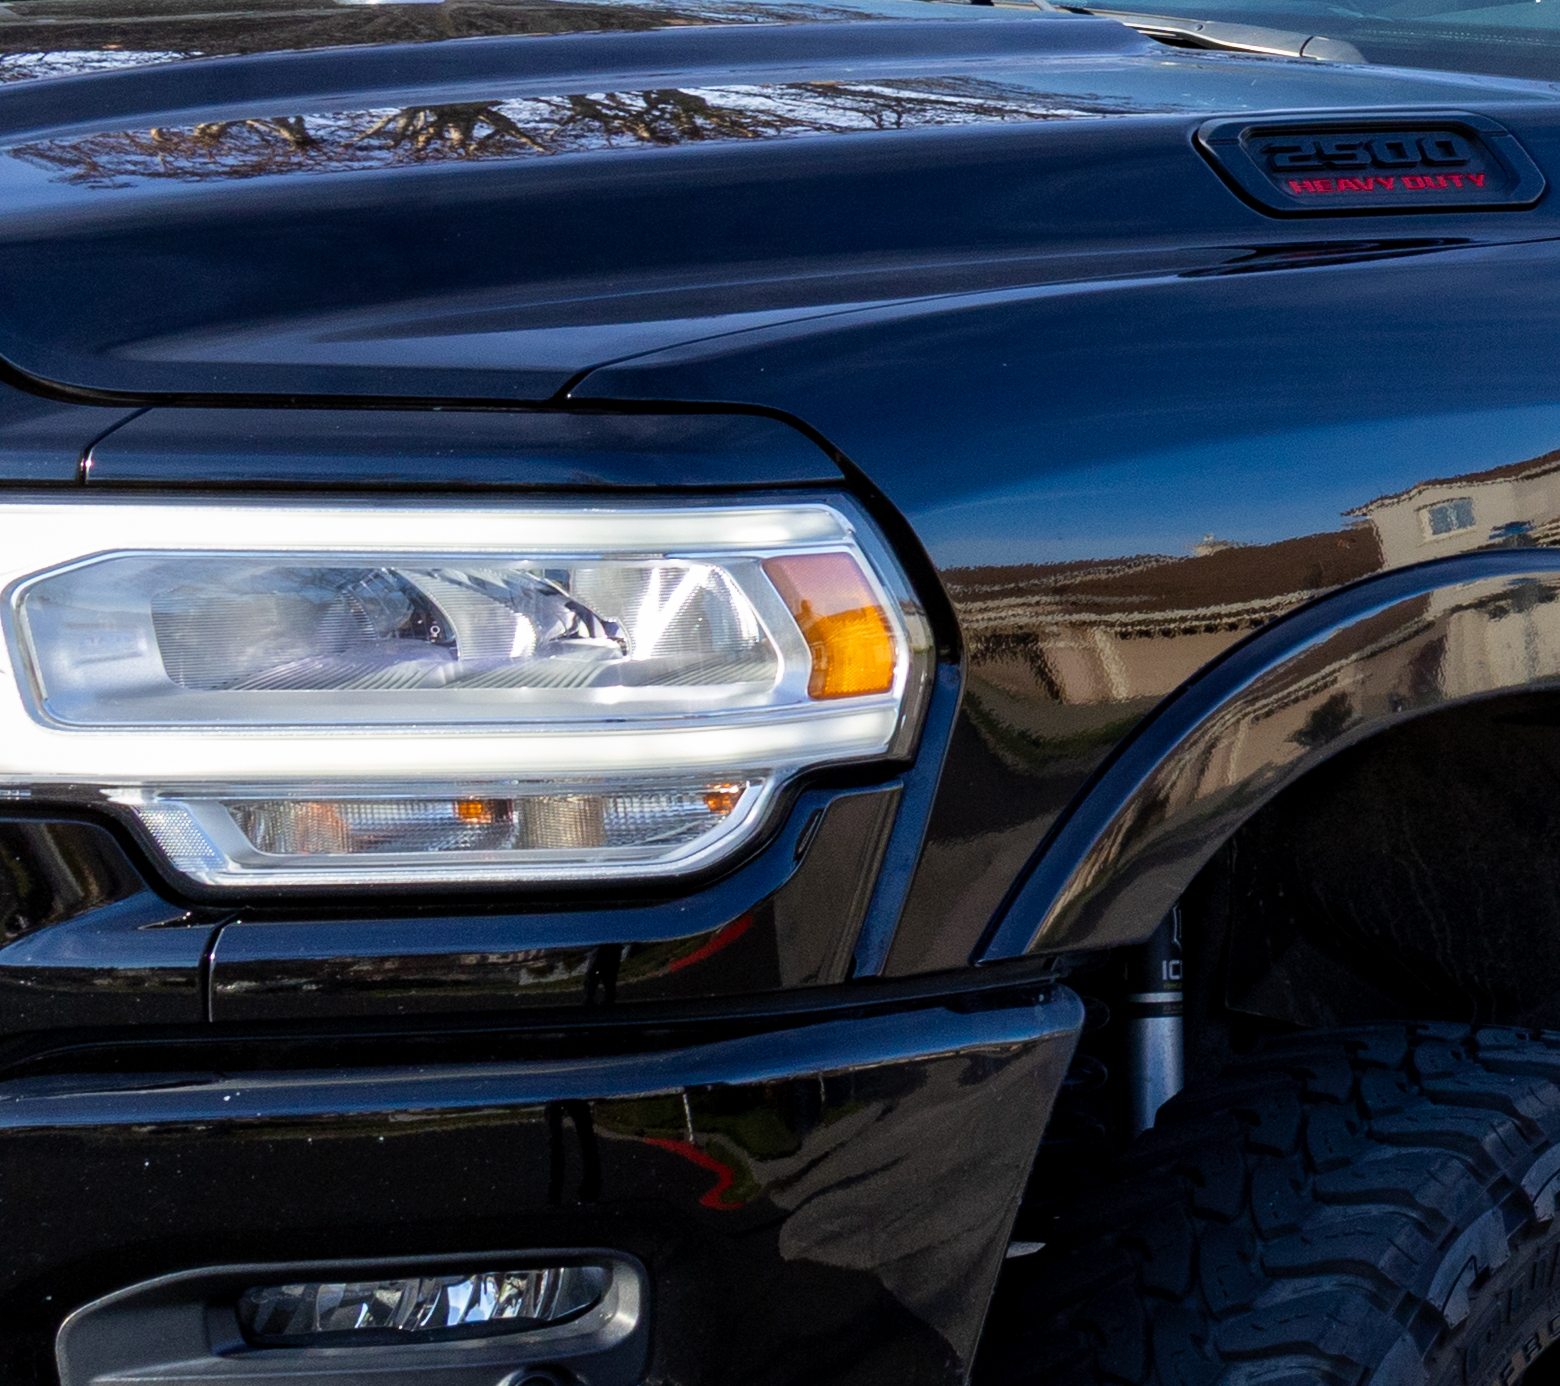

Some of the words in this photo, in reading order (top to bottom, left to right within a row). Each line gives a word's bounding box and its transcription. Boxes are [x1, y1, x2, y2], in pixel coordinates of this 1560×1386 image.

[1262, 138, 1472, 174] 2500
[1286, 176, 1395, 194] HEAVY
[1401, 172, 1487, 192] DUTY
